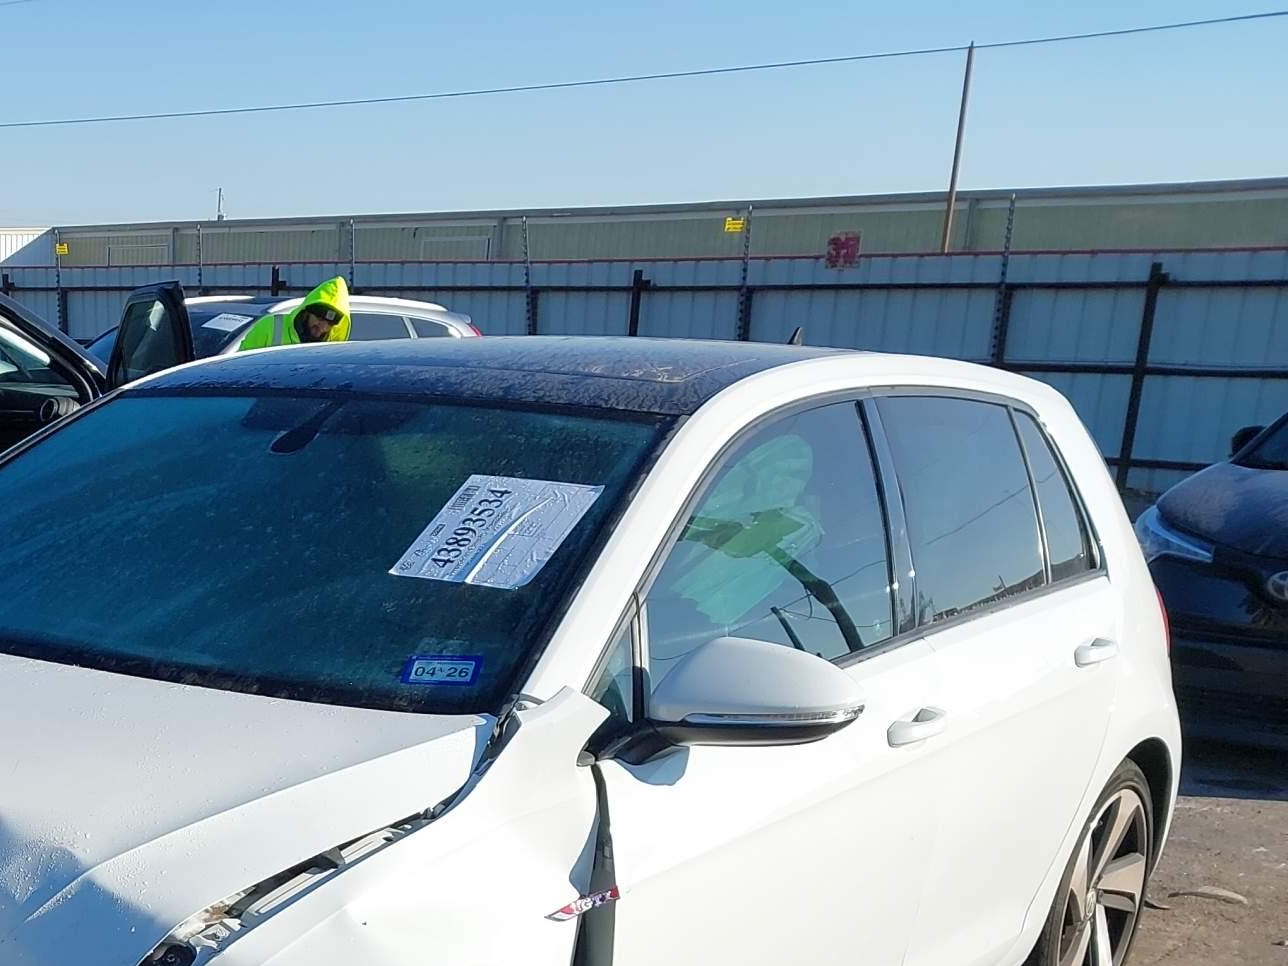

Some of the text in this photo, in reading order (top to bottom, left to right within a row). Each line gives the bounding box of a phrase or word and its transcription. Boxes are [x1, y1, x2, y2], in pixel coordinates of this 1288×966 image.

[430, 488, 513, 569] 43893534
[414, 666, 470, 679] 04 26
